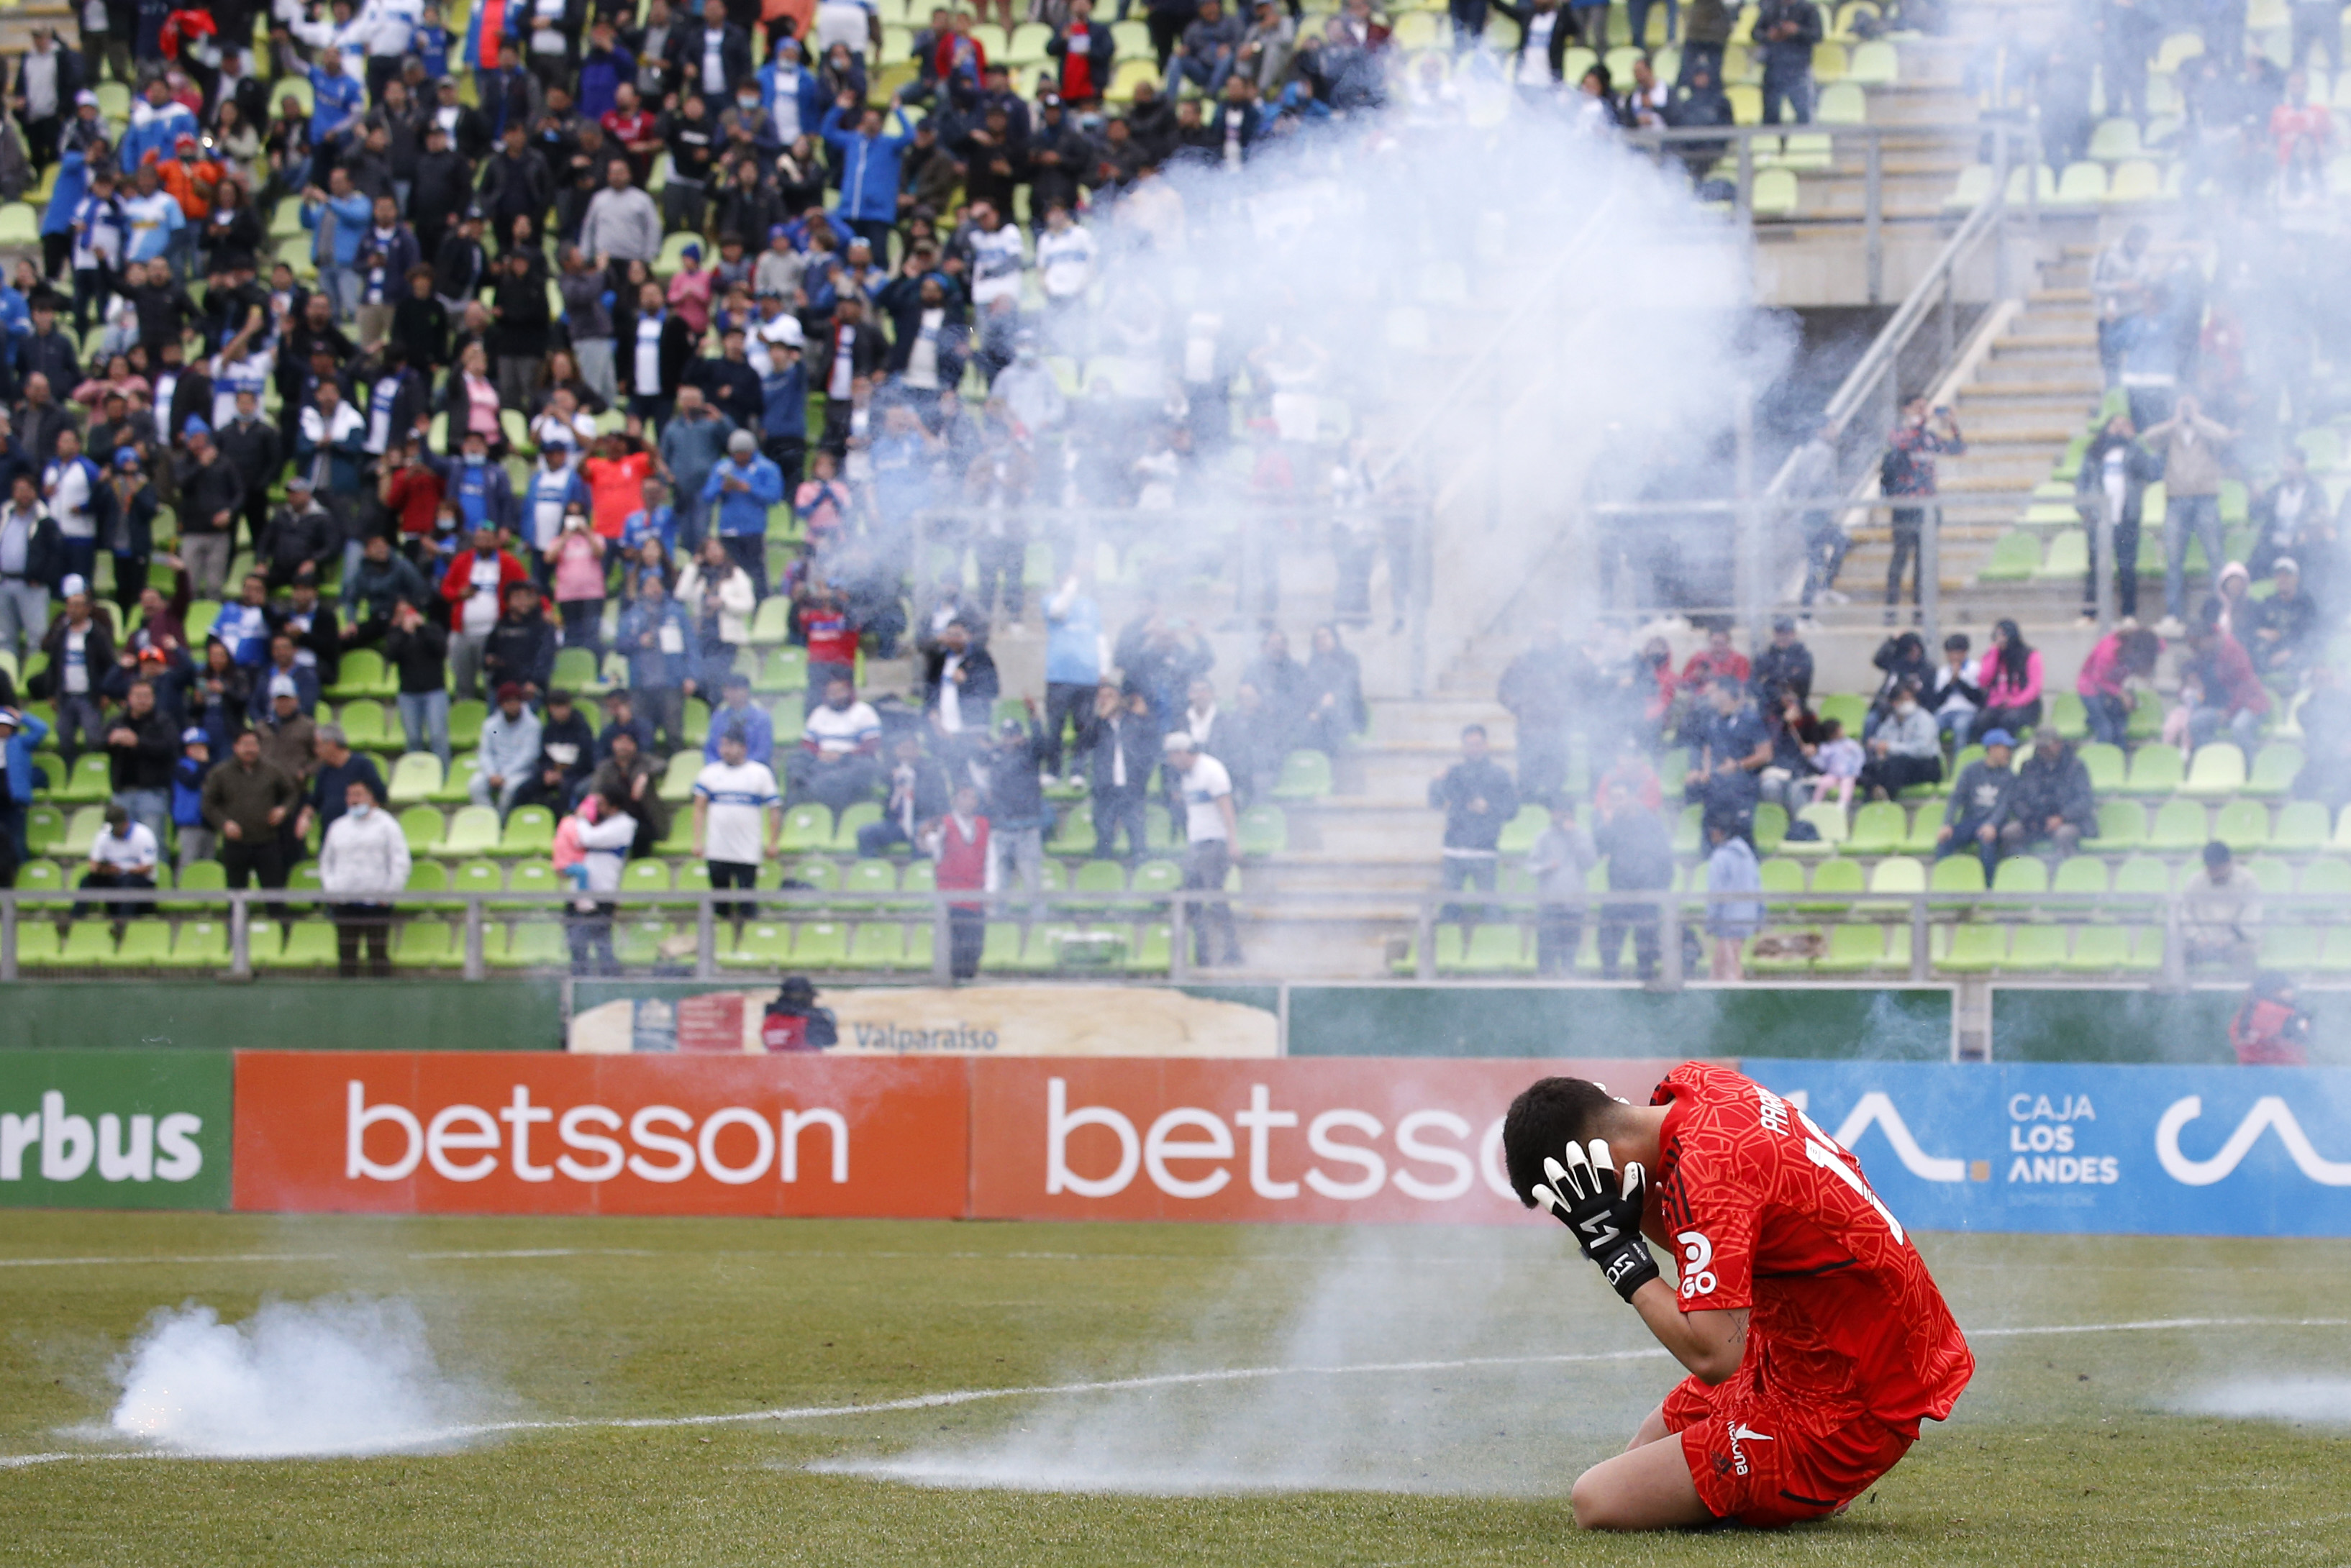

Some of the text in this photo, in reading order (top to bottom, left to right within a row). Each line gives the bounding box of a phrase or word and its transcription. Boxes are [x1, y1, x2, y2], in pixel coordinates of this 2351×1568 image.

[0, 1089, 203, 1182] rbus
[346, 1079, 849, 1185] betsson
[2008, 1093, 2096, 1122] CAJA
[1046, 1077, 1521, 1201] betss
[2010, 1124, 2075, 1154] LOS
[2007, 1155, 2120, 1185] ANDES
